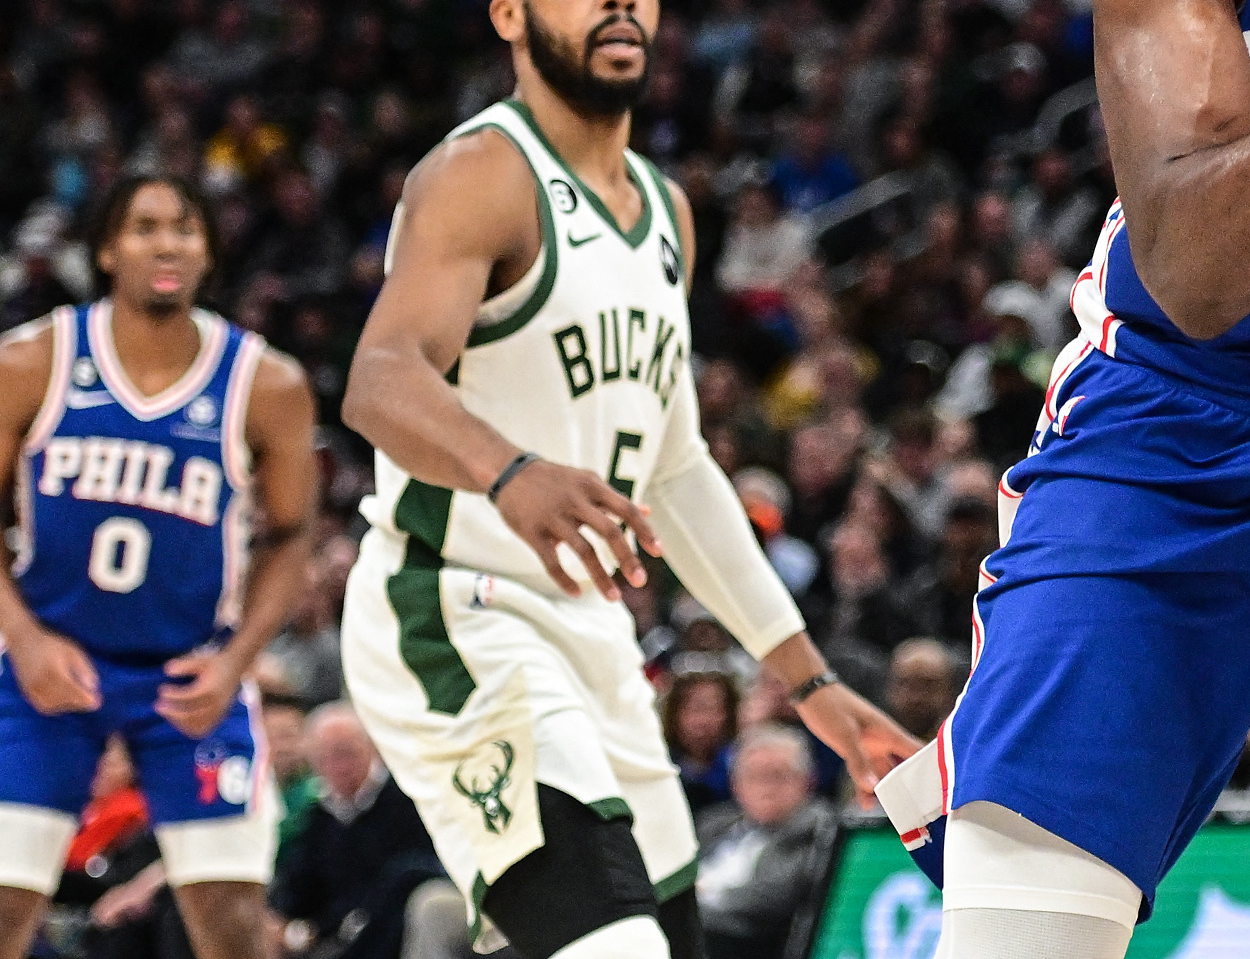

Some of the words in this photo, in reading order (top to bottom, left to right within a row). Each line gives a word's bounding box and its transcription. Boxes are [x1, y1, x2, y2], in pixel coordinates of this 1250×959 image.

[553, 306, 684, 411] BUCKS
[38, 435, 223, 525] PHILA
[88, 516, 151, 594] 0
